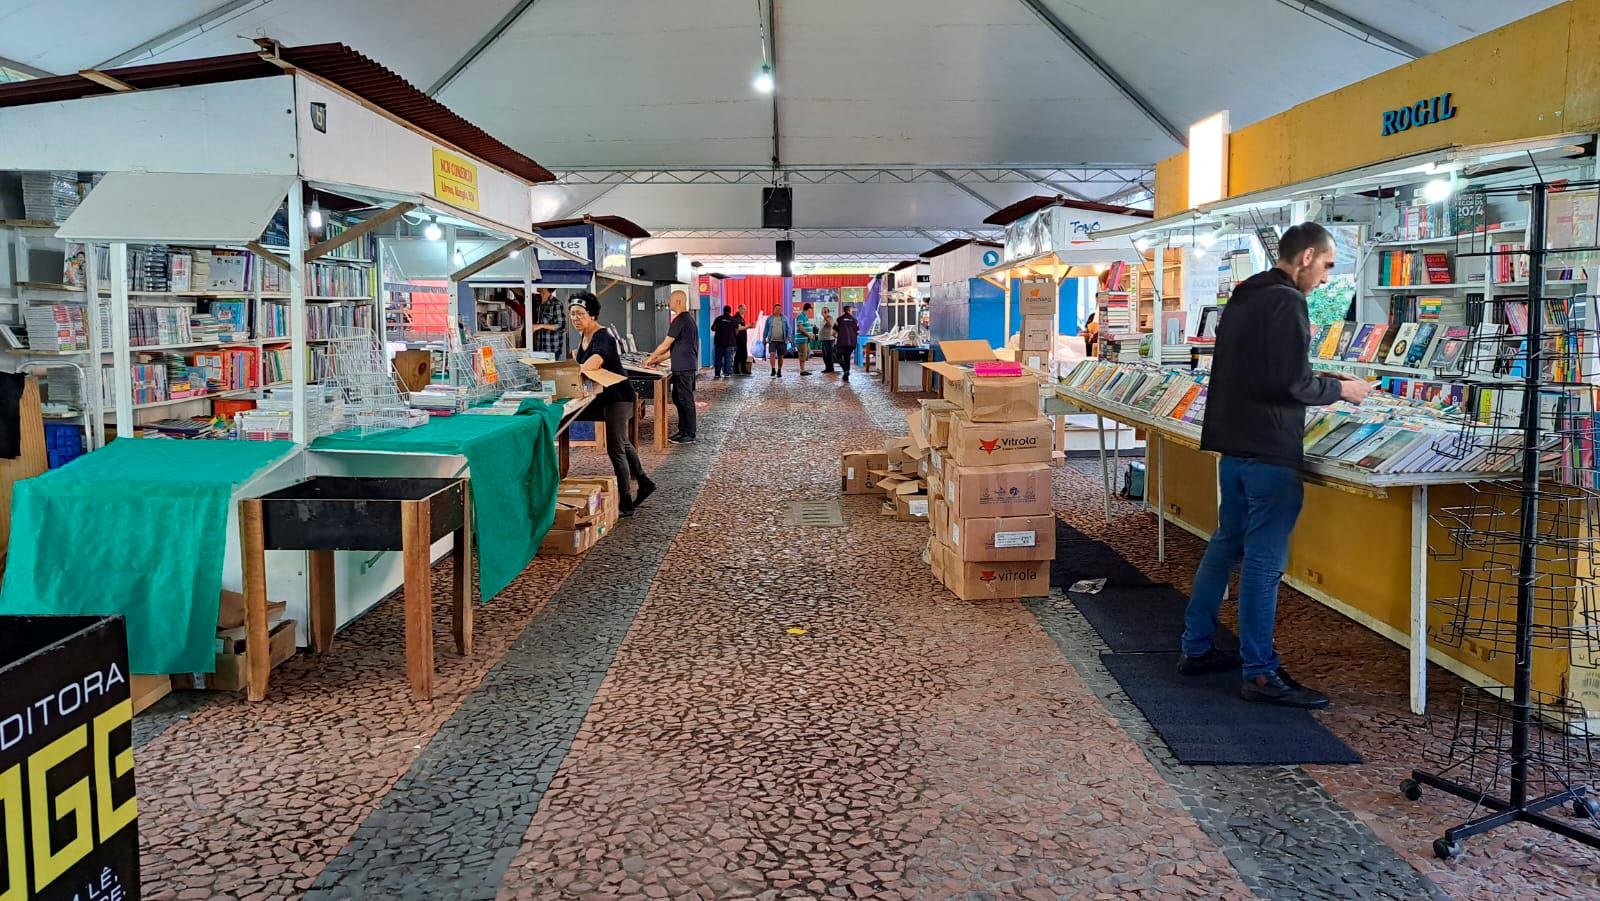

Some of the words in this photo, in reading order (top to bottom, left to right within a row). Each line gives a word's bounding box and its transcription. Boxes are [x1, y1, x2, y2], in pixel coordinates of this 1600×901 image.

[1381, 92, 1457, 136] ROGIL
[1455, 206, 1485, 217] 2024
[1001, 436, 1037, 446] Vitrola
[998, 568, 1037, 582] vitrola
[0, 662, 125, 751] DITORA
